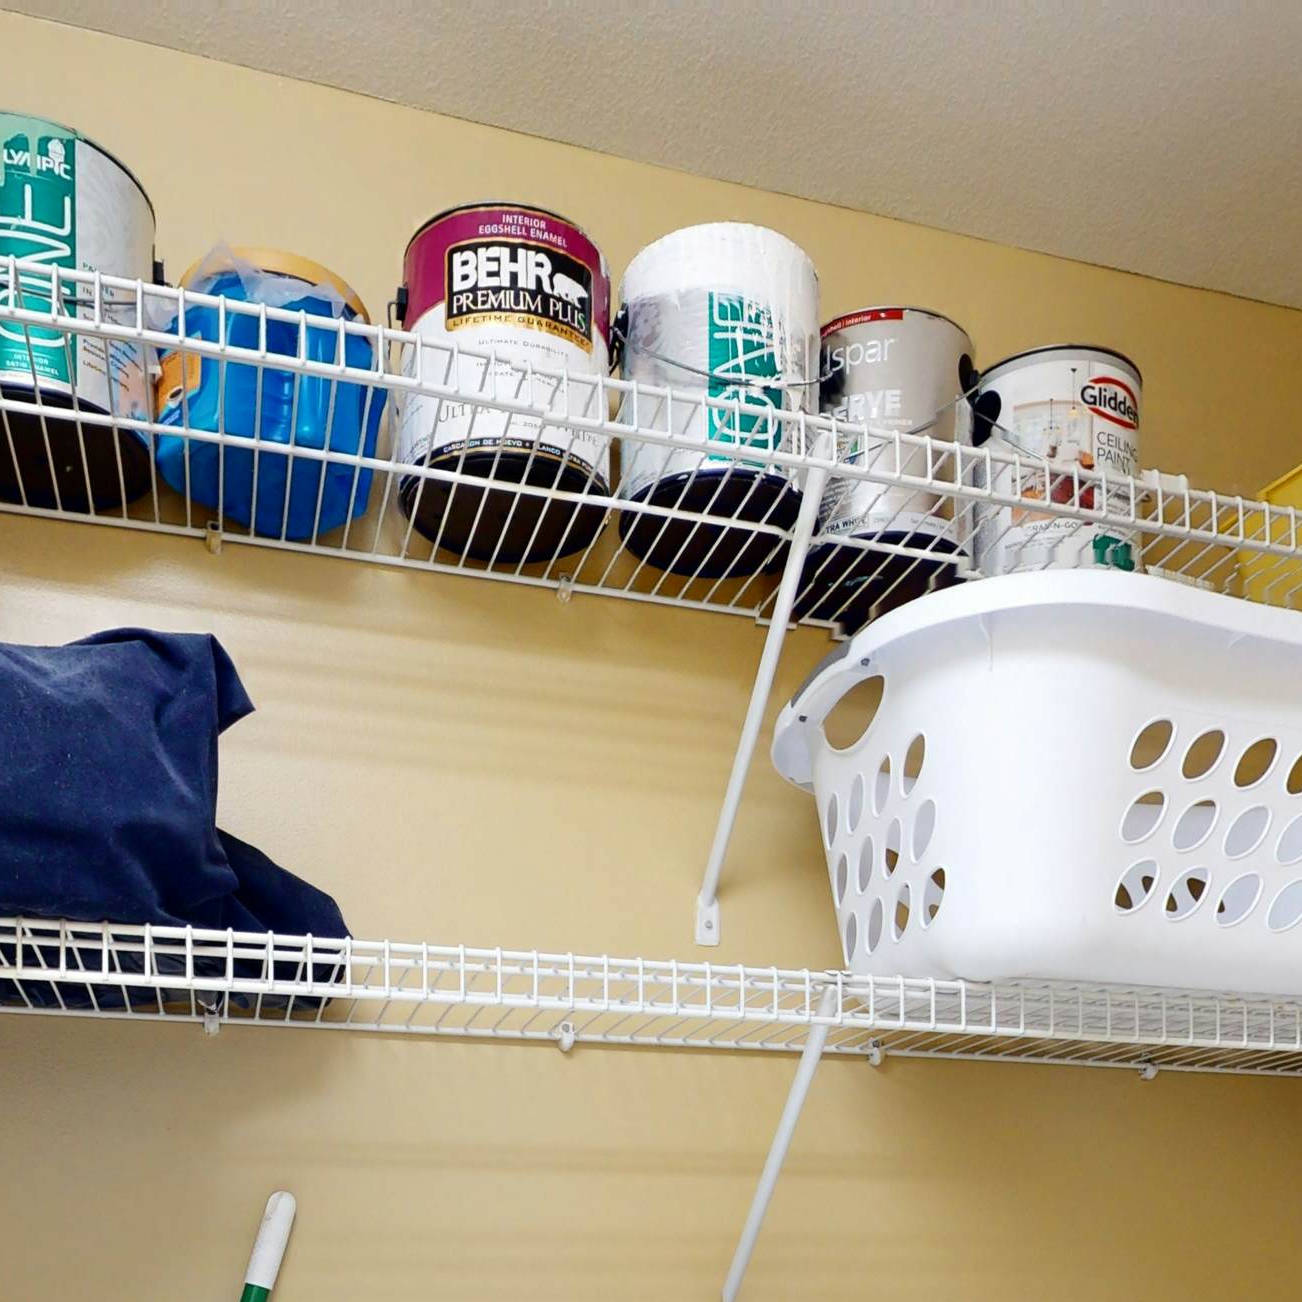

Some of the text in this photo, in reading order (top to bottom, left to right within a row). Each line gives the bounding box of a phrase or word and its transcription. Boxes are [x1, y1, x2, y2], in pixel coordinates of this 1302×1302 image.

[502, 213, 547, 230] INTERIOR
[478, 224, 568, 249] EGGSHELL ENAMEL
[452, 245, 553, 295] BEHR
[452, 289, 587, 333] PREMIUM PLUS
[452, 314, 512, 328] LIFETIME
[13, 352, 49, 364] INTEIOR
[1079, 384, 1140, 426] Glidden
[535, 445, 561, 455] LANCO
[1096, 431, 1139, 463] CEILING
[1096, 447, 1131, 476] PAINT
